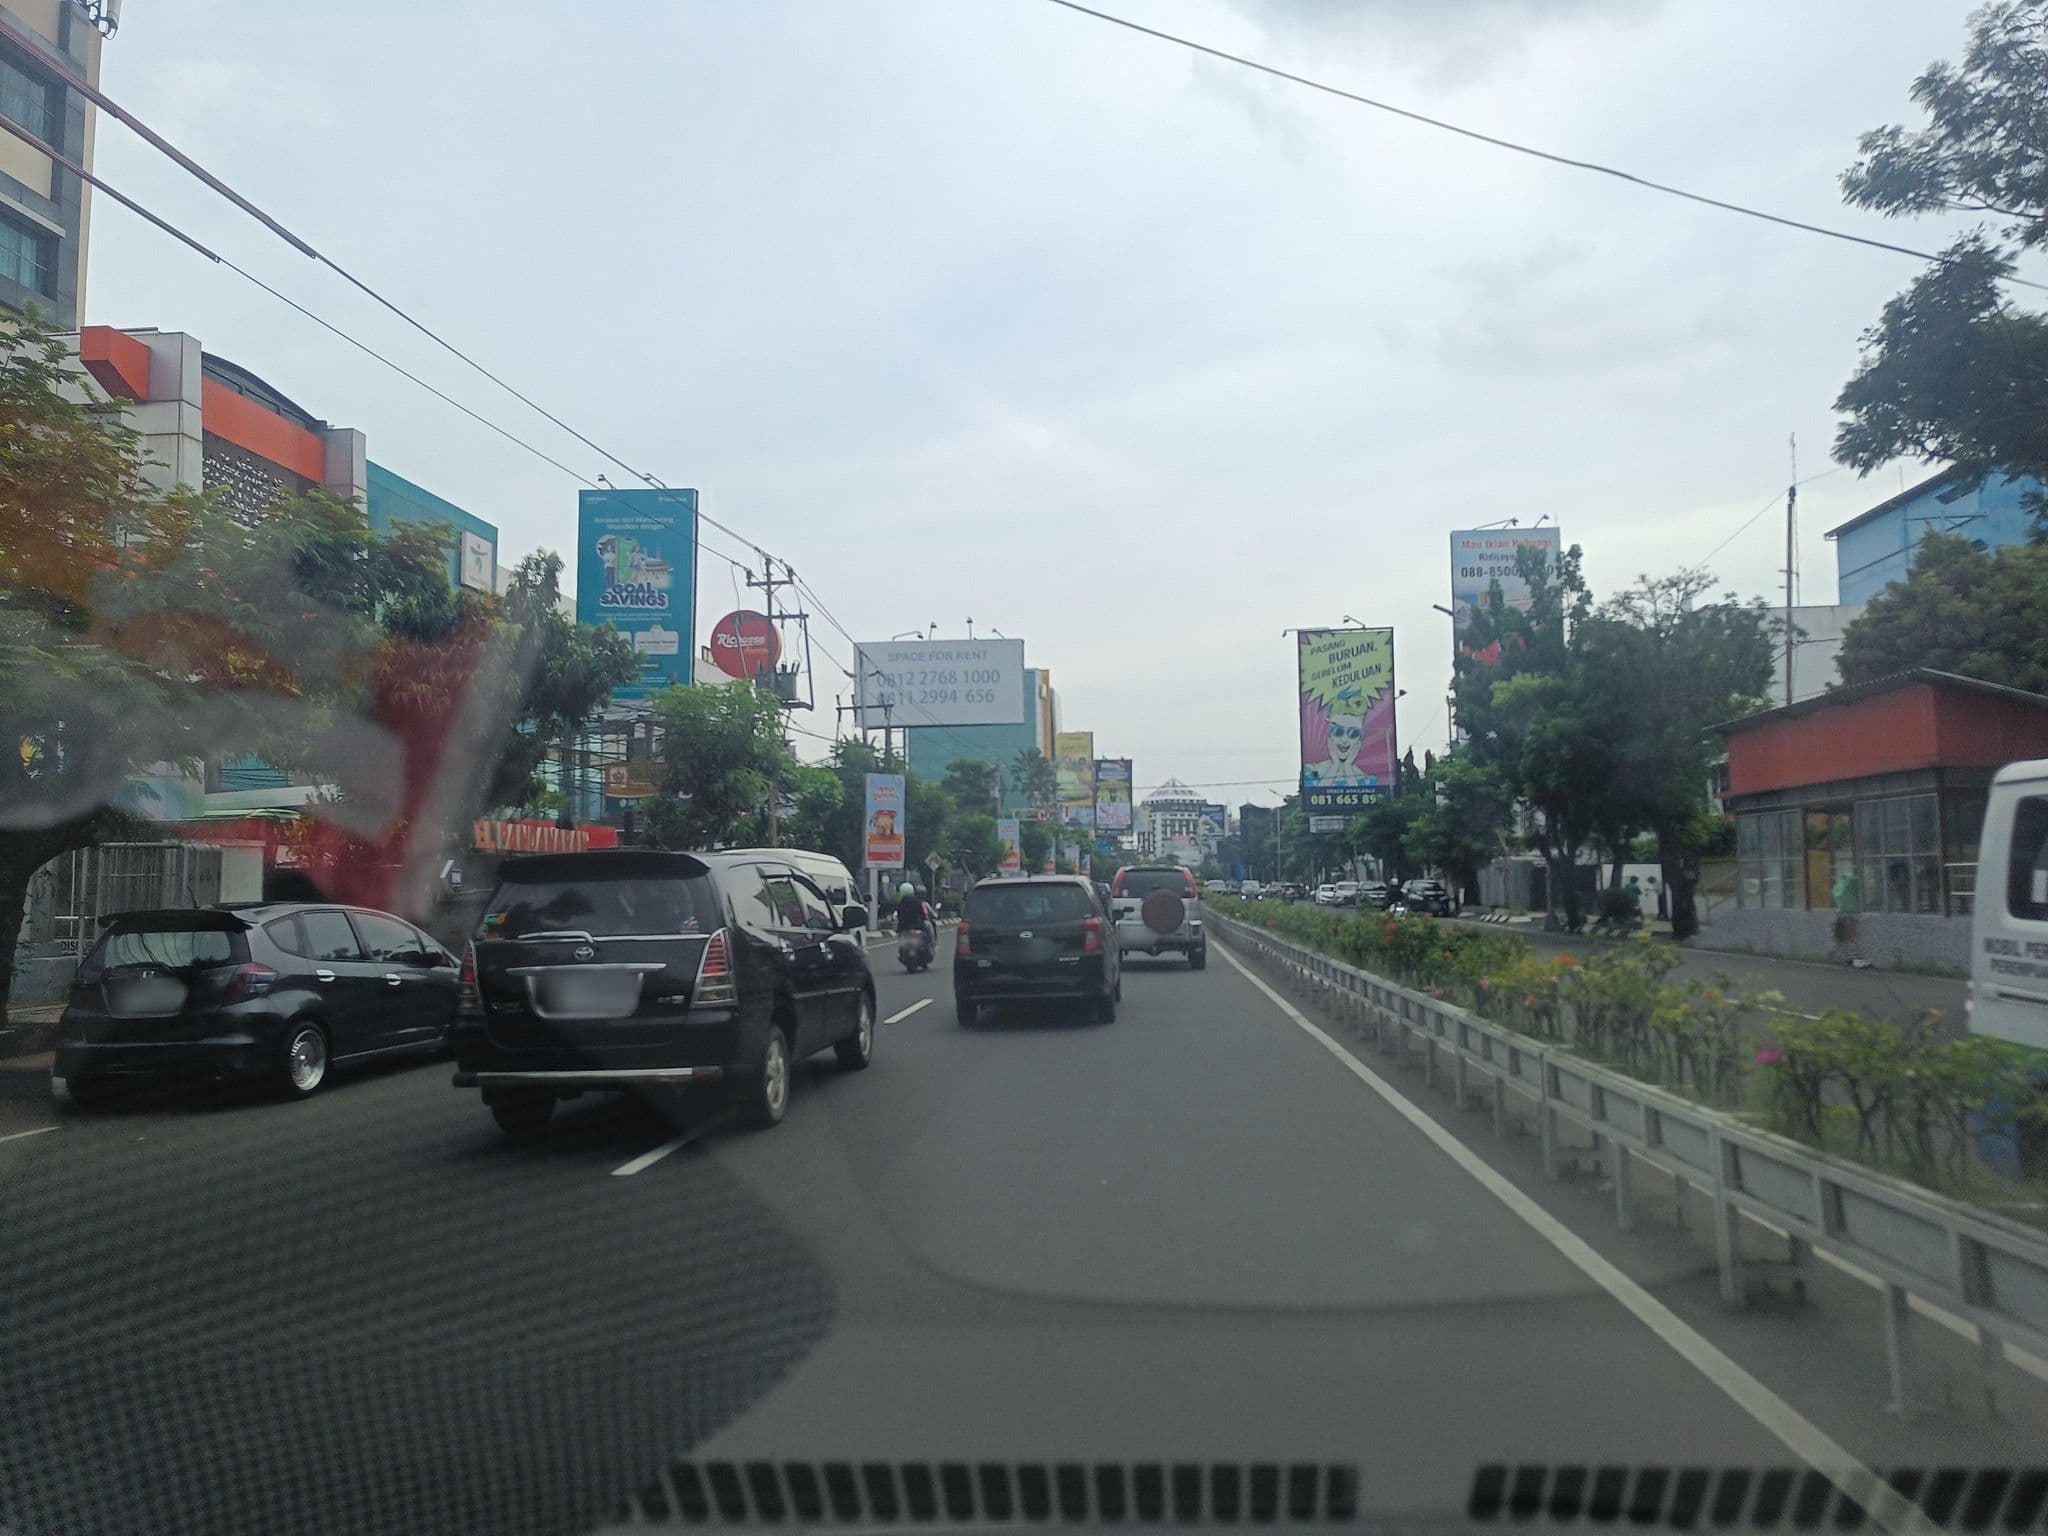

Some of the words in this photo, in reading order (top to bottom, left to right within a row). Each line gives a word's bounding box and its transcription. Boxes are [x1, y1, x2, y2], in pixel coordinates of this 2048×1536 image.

[612, 582, 656, 594] GOAL
[600, 593, 668, 608] SAVINGS
[888, 651, 926, 662] SPACE
[929, 650, 953, 662] FOR
[956, 648, 988, 661] RENT
[877, 671, 914, 688] 0812
[920, 671, 957, 685] 2768
[963, 669, 1000, 684] 1000
[1331, 663, 1382, 689] KEDULUAN
[921, 688, 957, 704] 2994
[966, 687, 995, 703] 656
[1311, 795, 1332, 806] 081
[1336, 794, 1358, 805] 665
